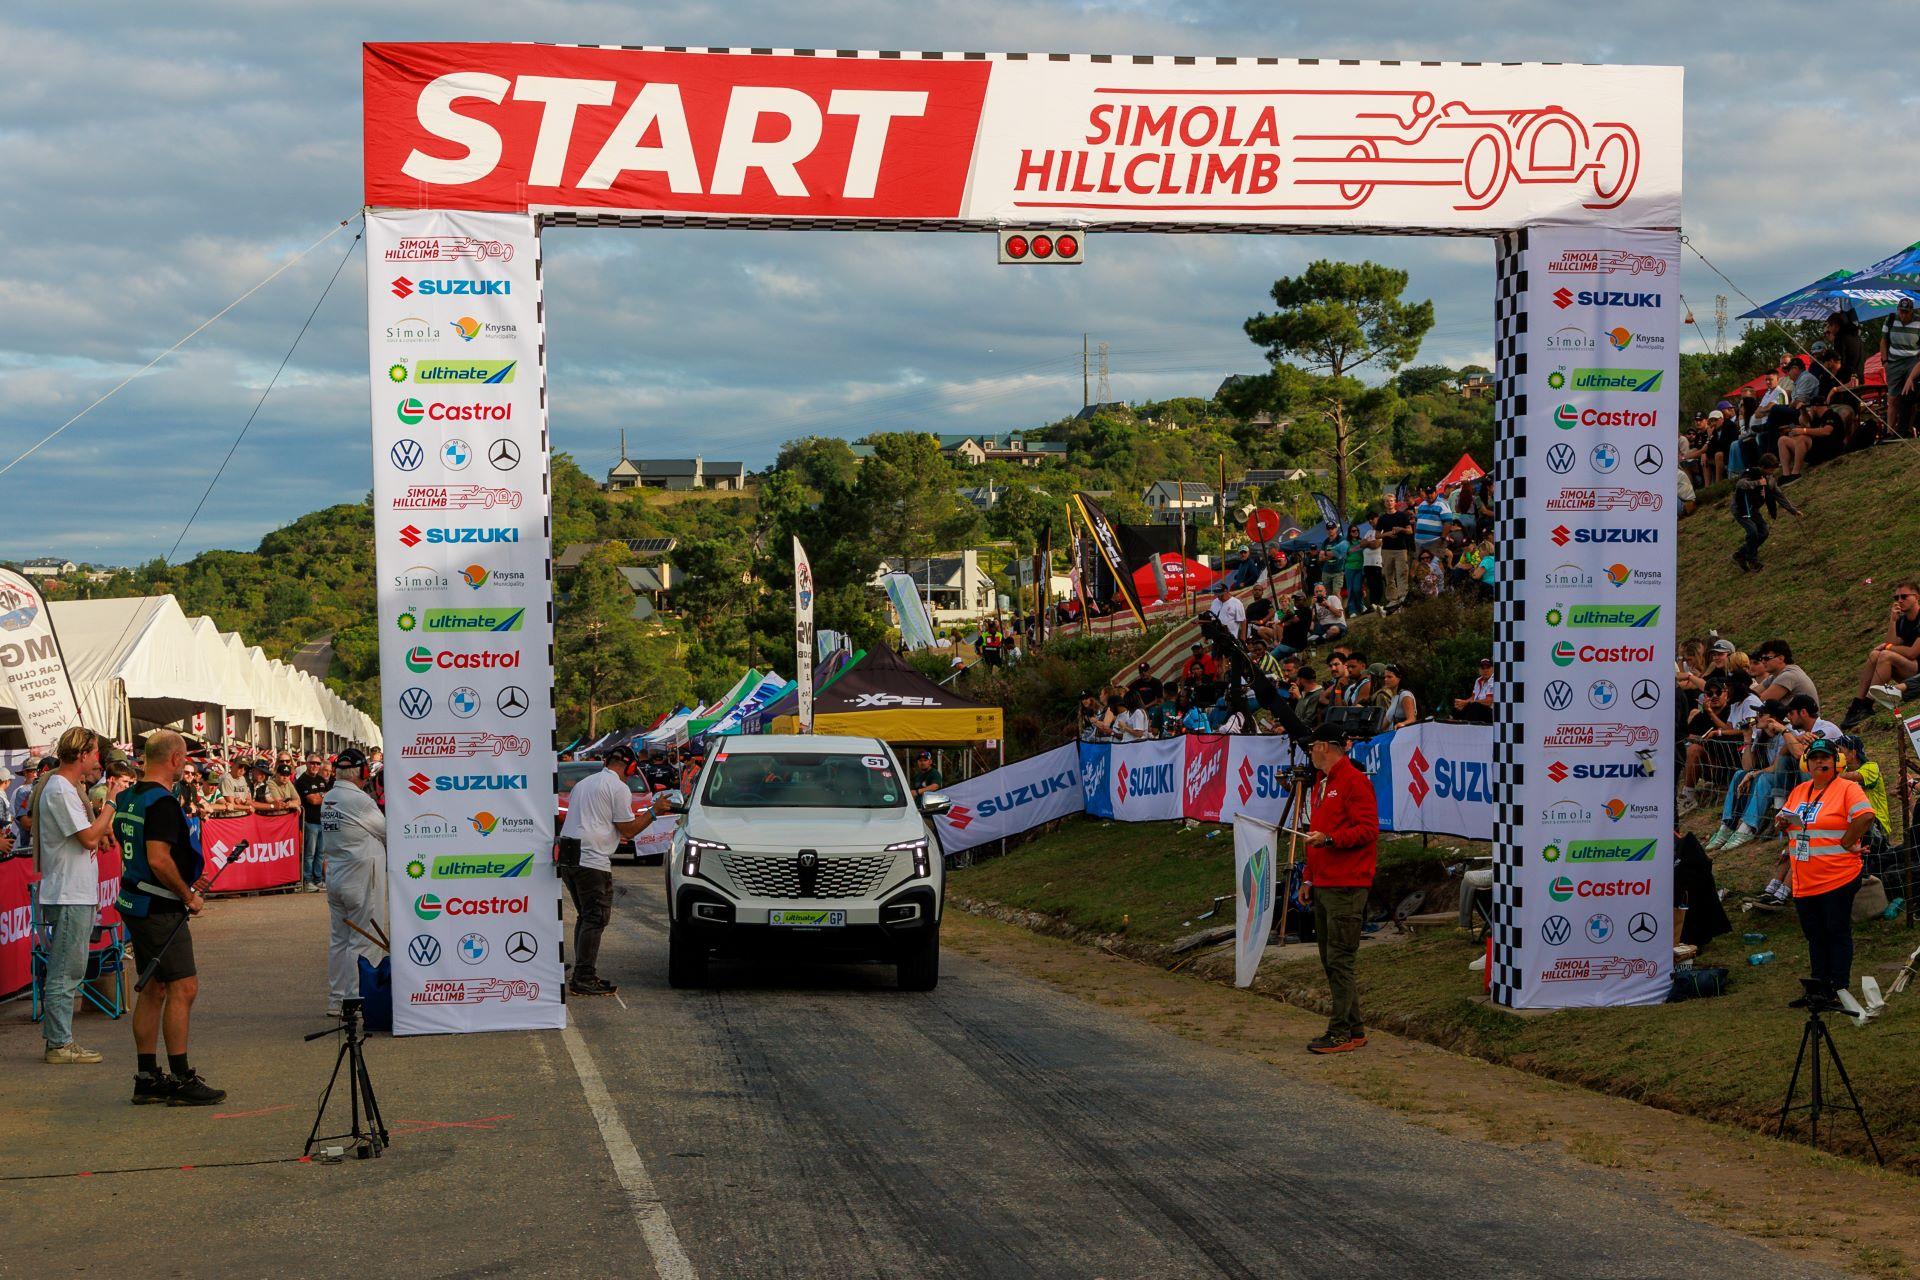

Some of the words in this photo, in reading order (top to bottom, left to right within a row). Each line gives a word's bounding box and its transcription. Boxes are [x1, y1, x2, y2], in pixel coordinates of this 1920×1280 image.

[1086, 105, 1280, 148] SIMOLA
[401, 71, 929, 198] START
[1014, 150, 1279, 194] HILLCLIMB
[399, 240, 438, 249] SIMOLA
[385, 250, 439, 259] HILLCLIMB
[1562, 253, 1598, 261] SIMOLA
[1549, 262, 1597, 271] HILLCLIMB
[419, 280, 510, 295] SUZUKI
[1578, 292, 1660, 307] SUZUKI
[386, 328, 440, 337] Simola
[485, 324, 516, 332] Knysna
[1547, 337, 1595, 346] Simola
[1637, 334, 1664, 343] Knysna
[421, 367, 487, 379] ultimate
[1577, 374, 1637, 387] ultimate
[429, 403, 511, 420] Castrol
[1582, 409, 1656, 426] Castrol
[408, 489, 447, 497] SIMOLA
[393, 499, 447, 507] HILLCLIMB
[1547, 500, 1595, 508] HILLCLIMB
[426, 528, 518, 543] SUZUKI
[1575, 529, 1658, 542] SUZUKI
[494, 571, 524, 579] Knysna
[1546, 574, 1592, 583] Simola
[1634, 570, 1661, 579] Knysna
[395, 577, 448, 586] Simola
[430, 614, 495, 627] ultimate
[1574, 610, 1634, 623] ultimate
[437, 650, 519, 668] Castrol
[1579, 646, 1653, 662] Castrol
[857, 693, 942, 707] XPEL
[1556, 727, 1593, 735] SIMOLA
[416, 737, 456, 745] SIMOLA
[1544, 736, 1593, 744] HILLCLIMB
[402, 746, 456, 755] HILLCLIMB
[436, 775, 527, 791] SUZUKI
[1130, 763, 1174, 797] SUZUKI
[977, 770, 1076, 818] SUZUKI
[1631, 804, 1658, 812] Knysna
[1542, 811, 1591, 820] Simola
[502, 817, 533, 826] Knysna
[404, 824, 457, 834] Simola
[1572, 846, 1630, 858] ultimate
[439, 862, 504, 875] ultimate
[1577, 879, 1650, 897] Castrol
[446, 896, 528, 915] Castrol
[830, 913, 843, 924] GP
[1554, 961, 1589, 969] SIMOLA
[1542, 970, 1589, 979] HILLCLIMB
[425, 983, 464, 992] SIMOLA
[411, 992, 464, 1002] HILLCLIMB
